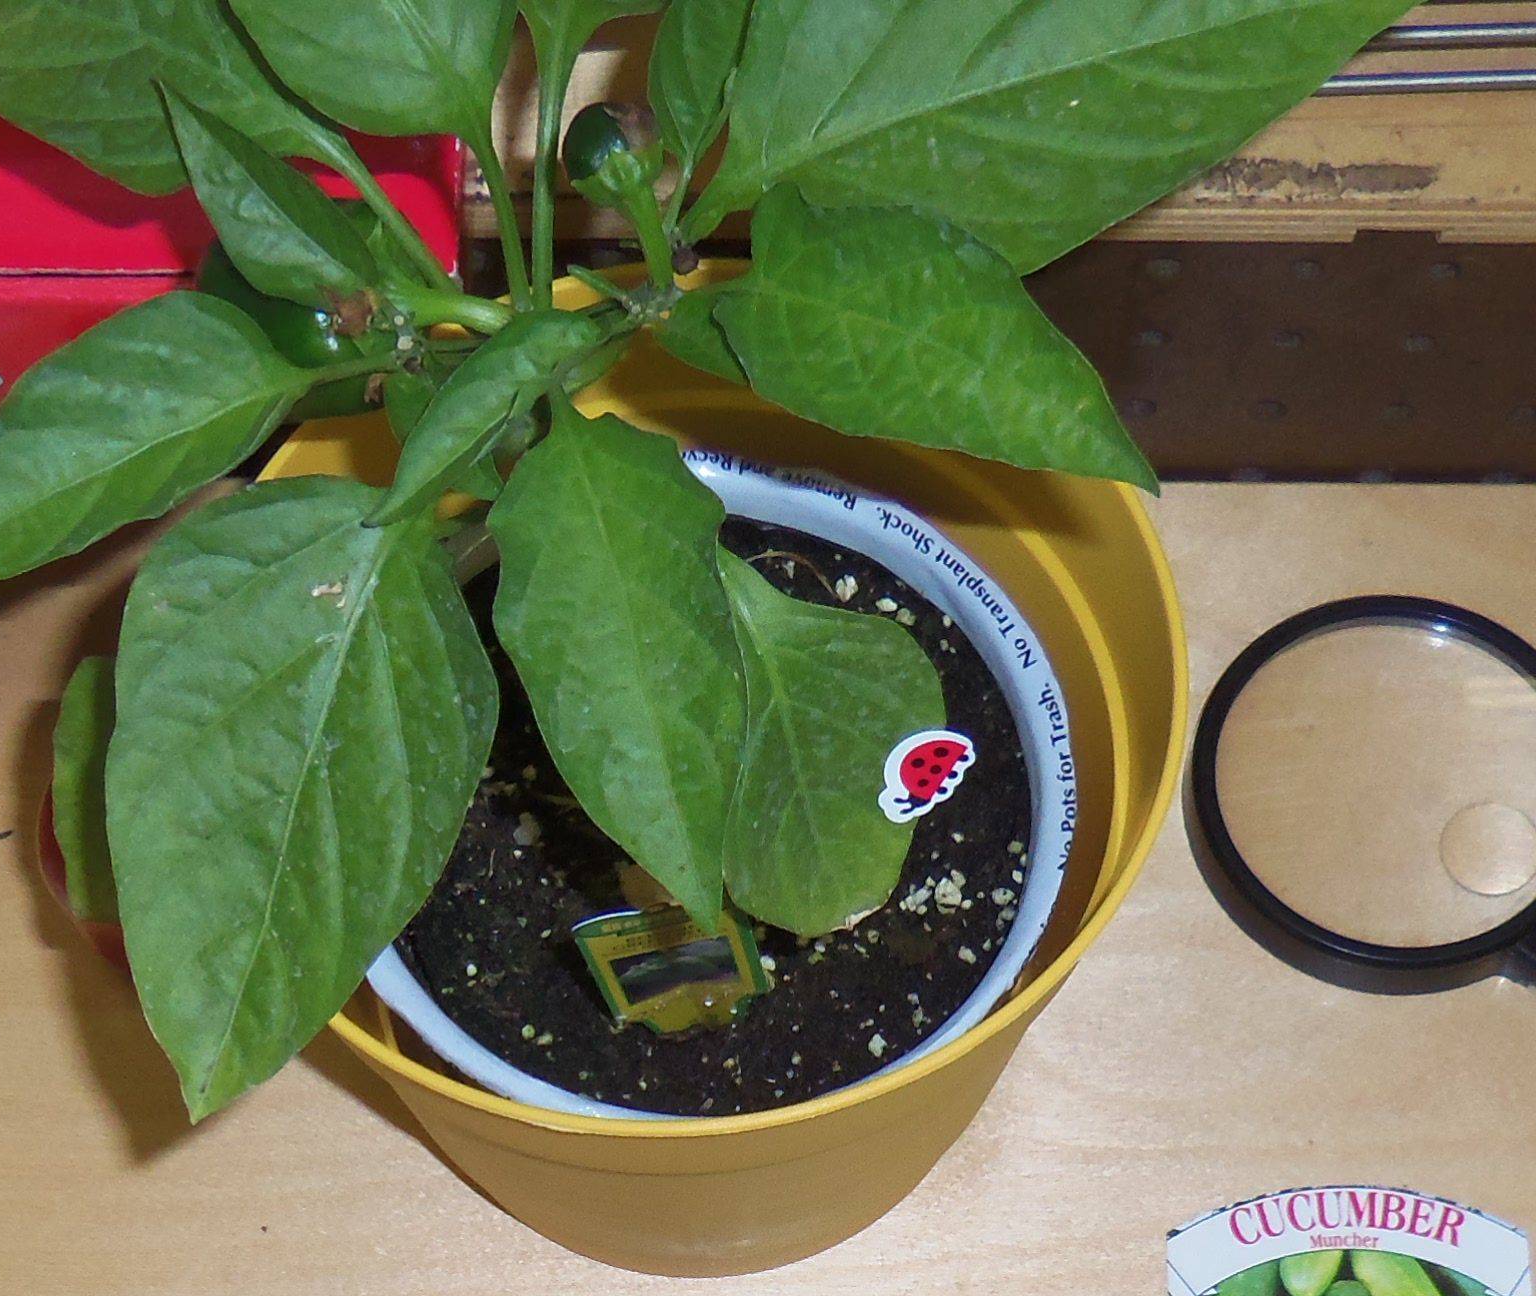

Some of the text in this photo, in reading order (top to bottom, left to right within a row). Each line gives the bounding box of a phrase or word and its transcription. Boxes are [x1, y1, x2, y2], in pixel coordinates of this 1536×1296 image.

[876, 506, 935, 555] Shock.
[935, 547, 1016, 639] Transplant
[1014, 637, 1038, 669] No
[1038, 682, 1067, 747] Trash.
[1057, 752, 1075, 783] for
[1061, 788, 1077, 833] Pots
[1228, 1190, 1466, 1248] CUCUMBER
[1309, 1232, 1380, 1249] Muncher
